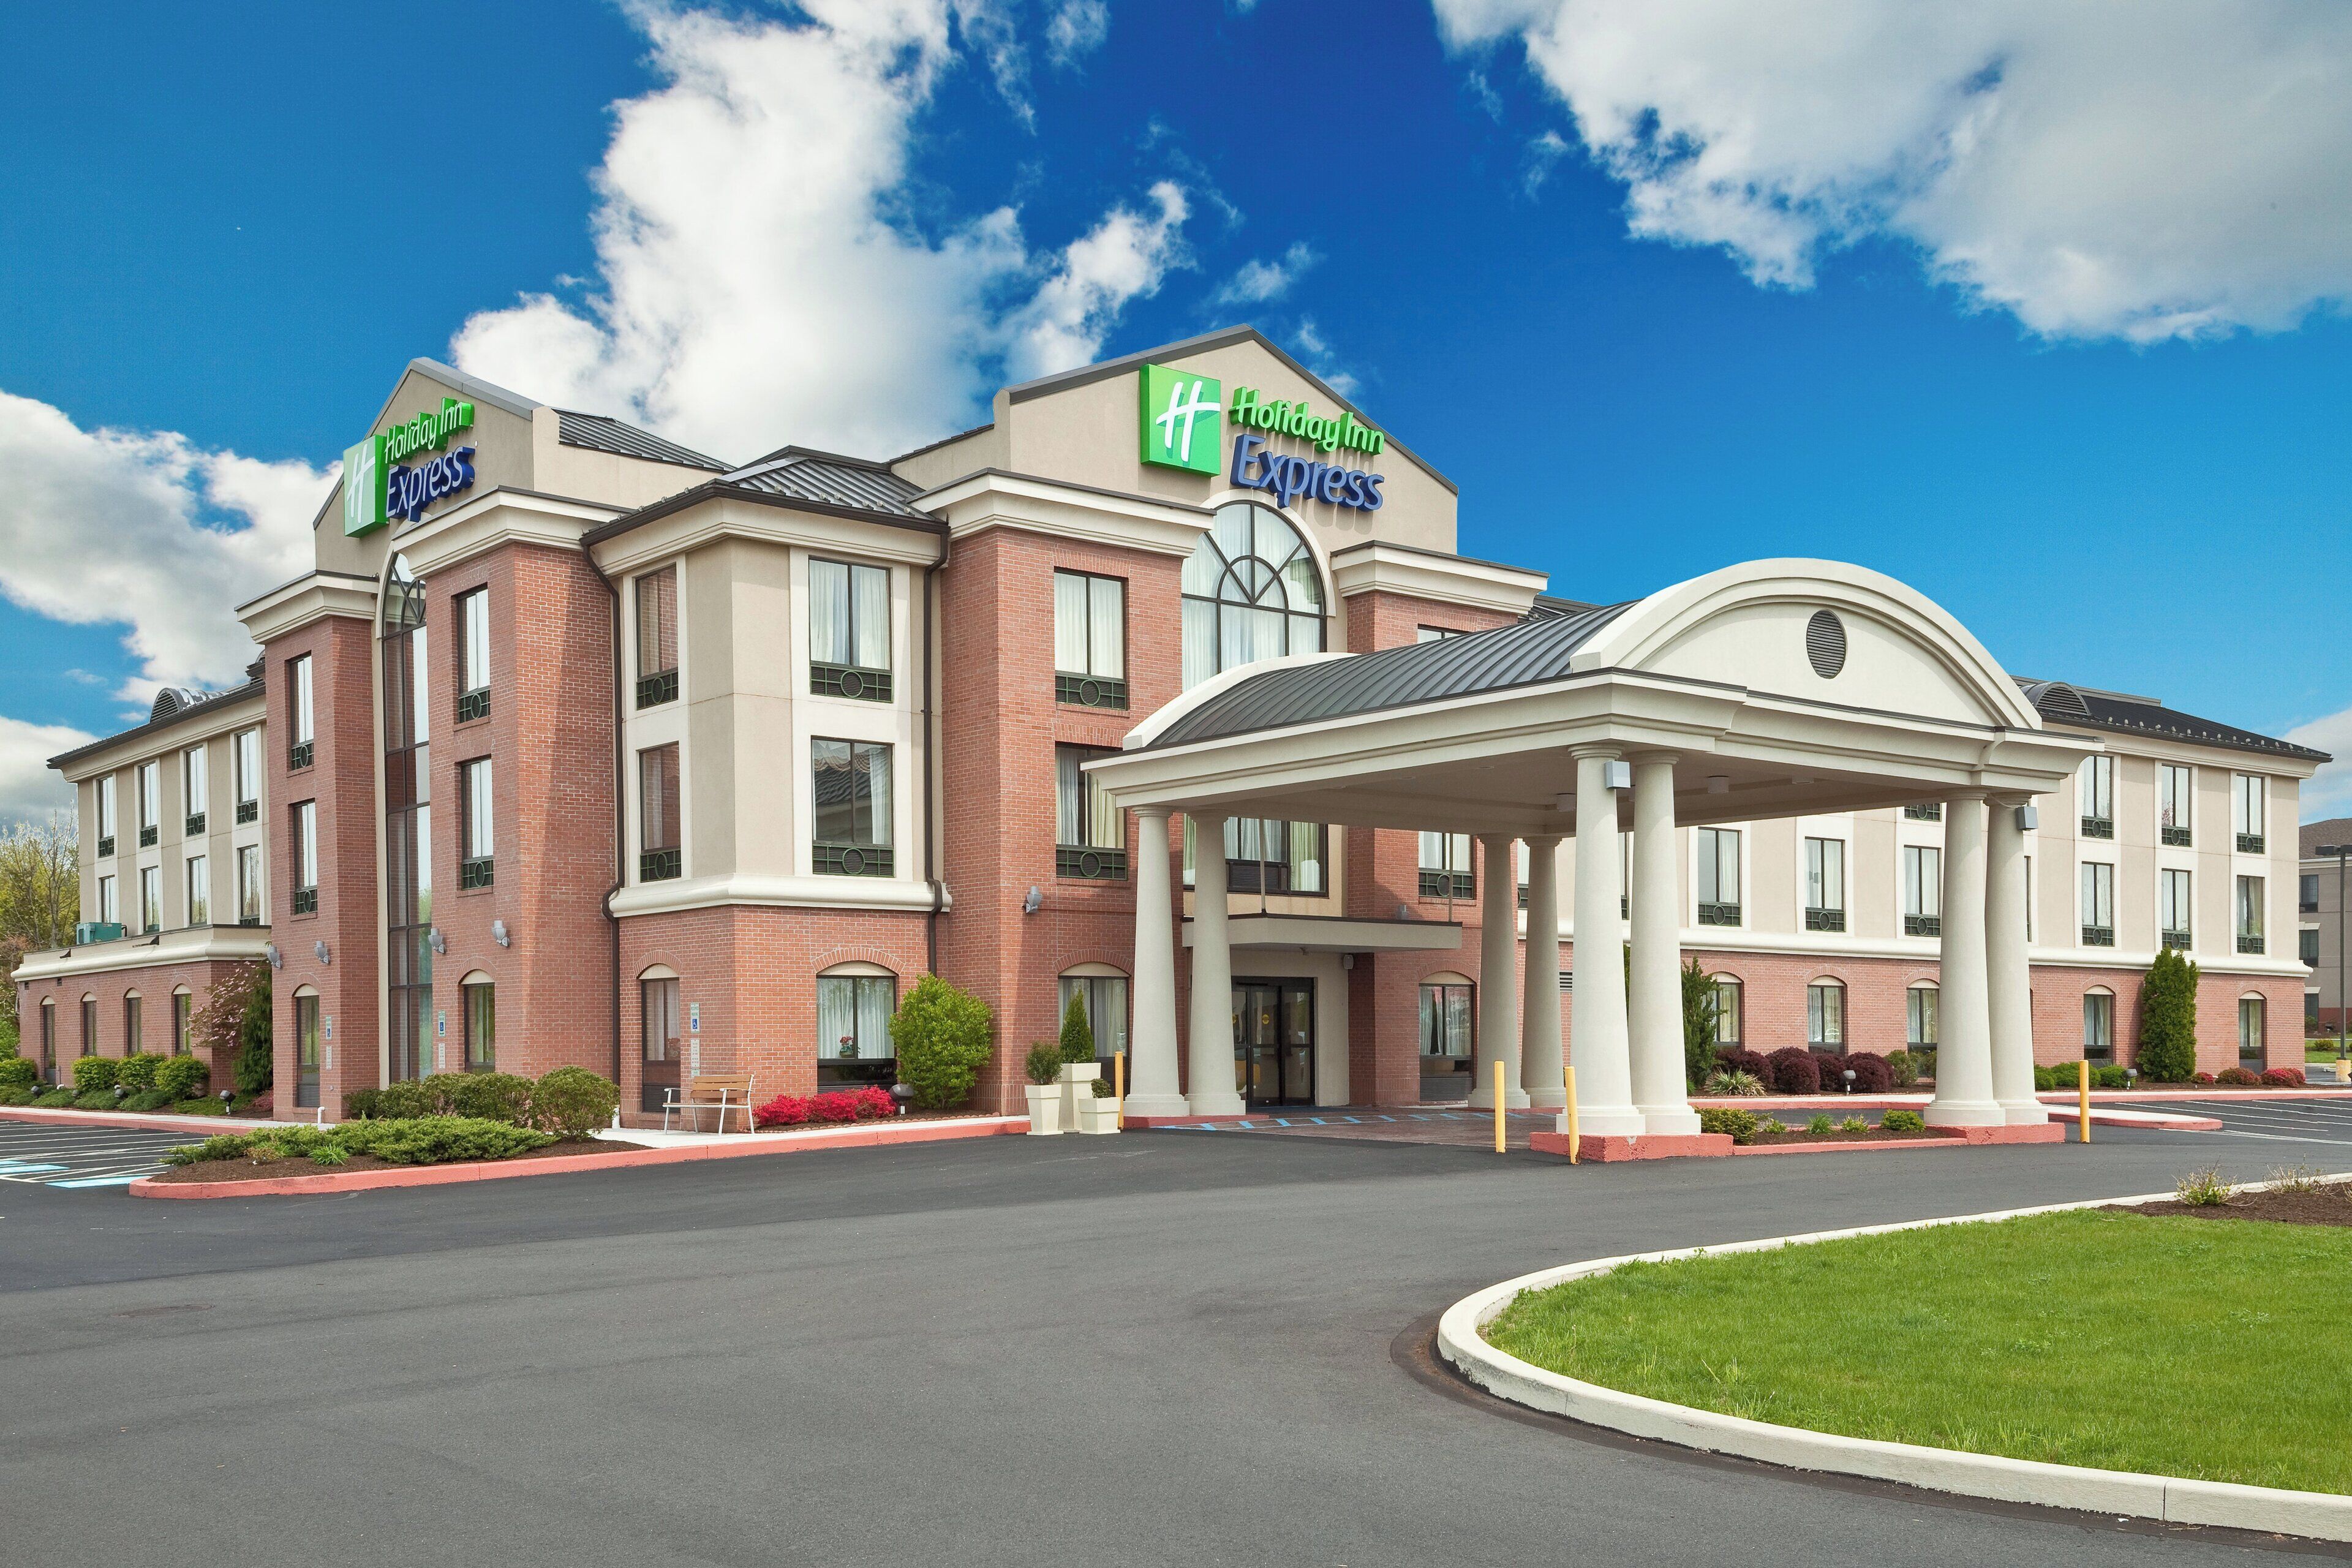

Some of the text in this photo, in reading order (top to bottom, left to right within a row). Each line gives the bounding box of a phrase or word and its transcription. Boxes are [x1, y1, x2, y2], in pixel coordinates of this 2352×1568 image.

[385, 397, 470, 464] Holiday Inn
[1229, 387, 1384, 455] Holiday Inn
[386, 446, 473, 523] Express
[1231, 434, 1385, 511] Express
